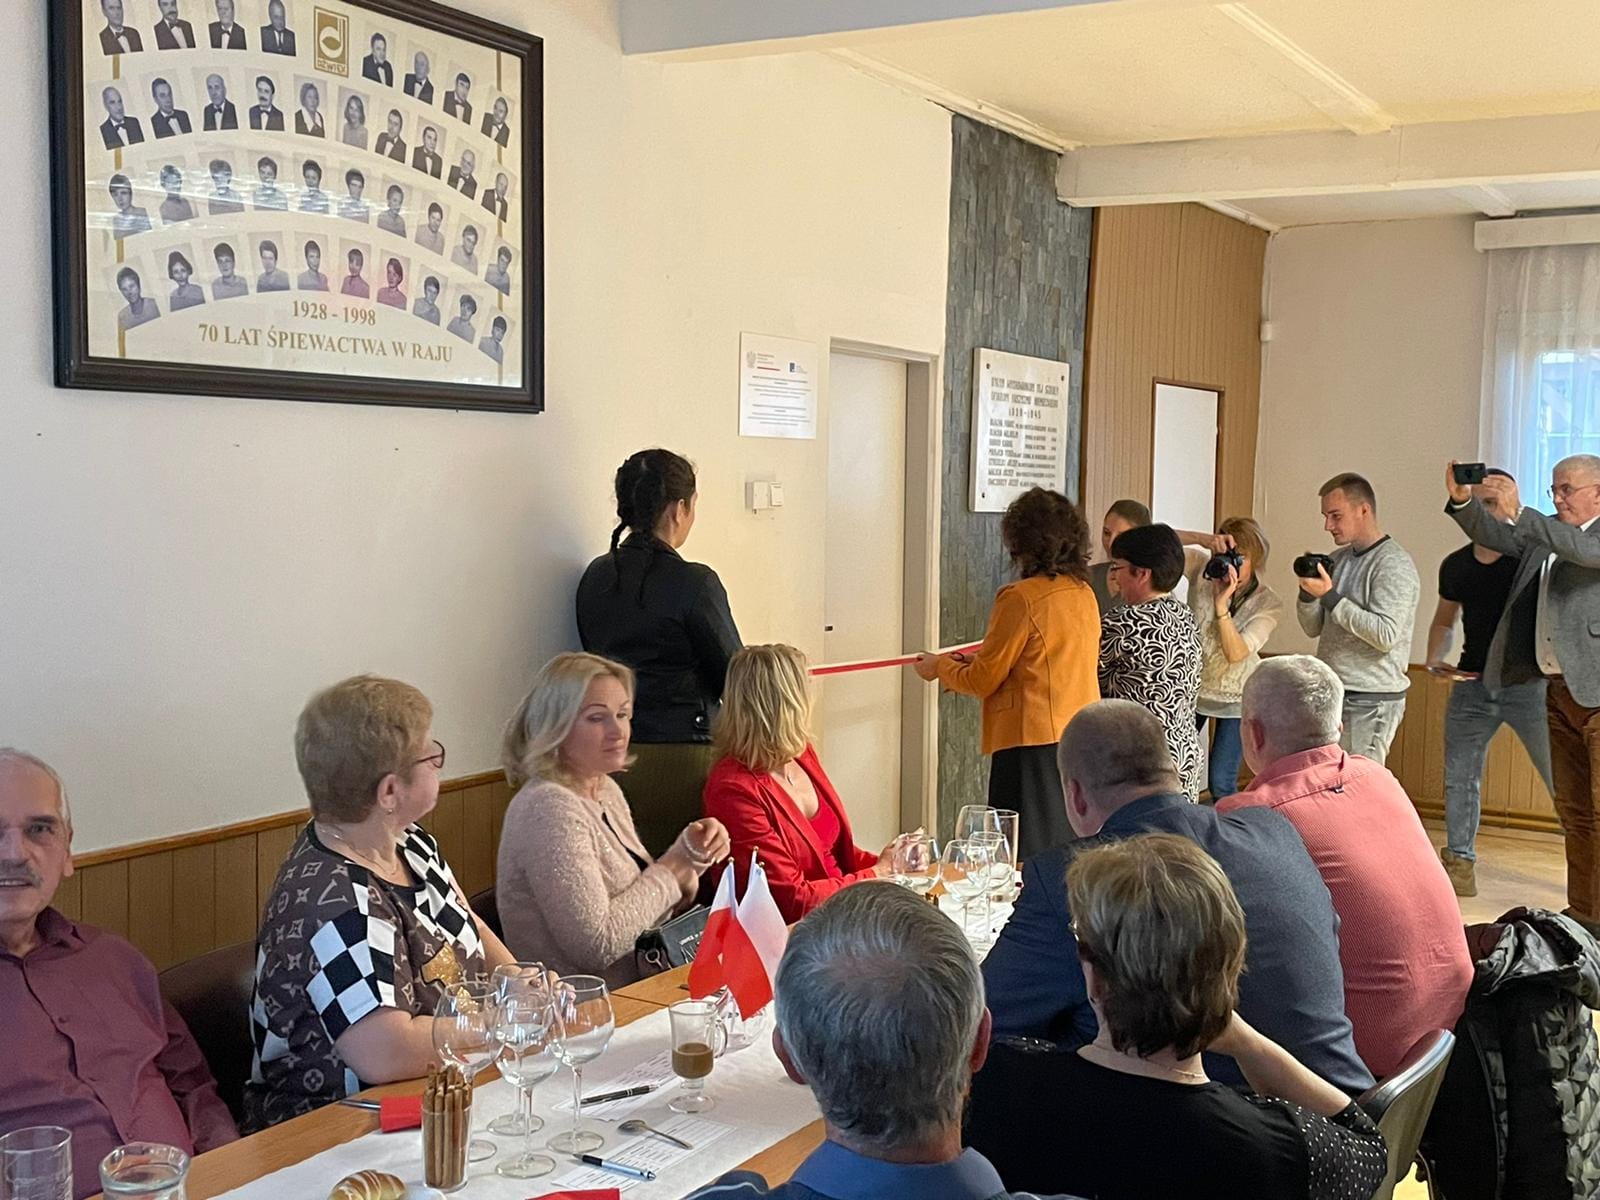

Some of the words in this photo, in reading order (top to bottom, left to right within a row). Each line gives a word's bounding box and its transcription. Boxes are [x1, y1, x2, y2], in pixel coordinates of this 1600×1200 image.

[292, 300, 328, 320] 1928
[343, 306, 376, 326] 1998
[198, 324, 218, 342] 70
[224, 326, 262, 346] LAT
[267, 325, 387, 357] ŚPIEWACTWA
[392, 341, 408, 357] W
[412, 343, 453, 362] RAJU
